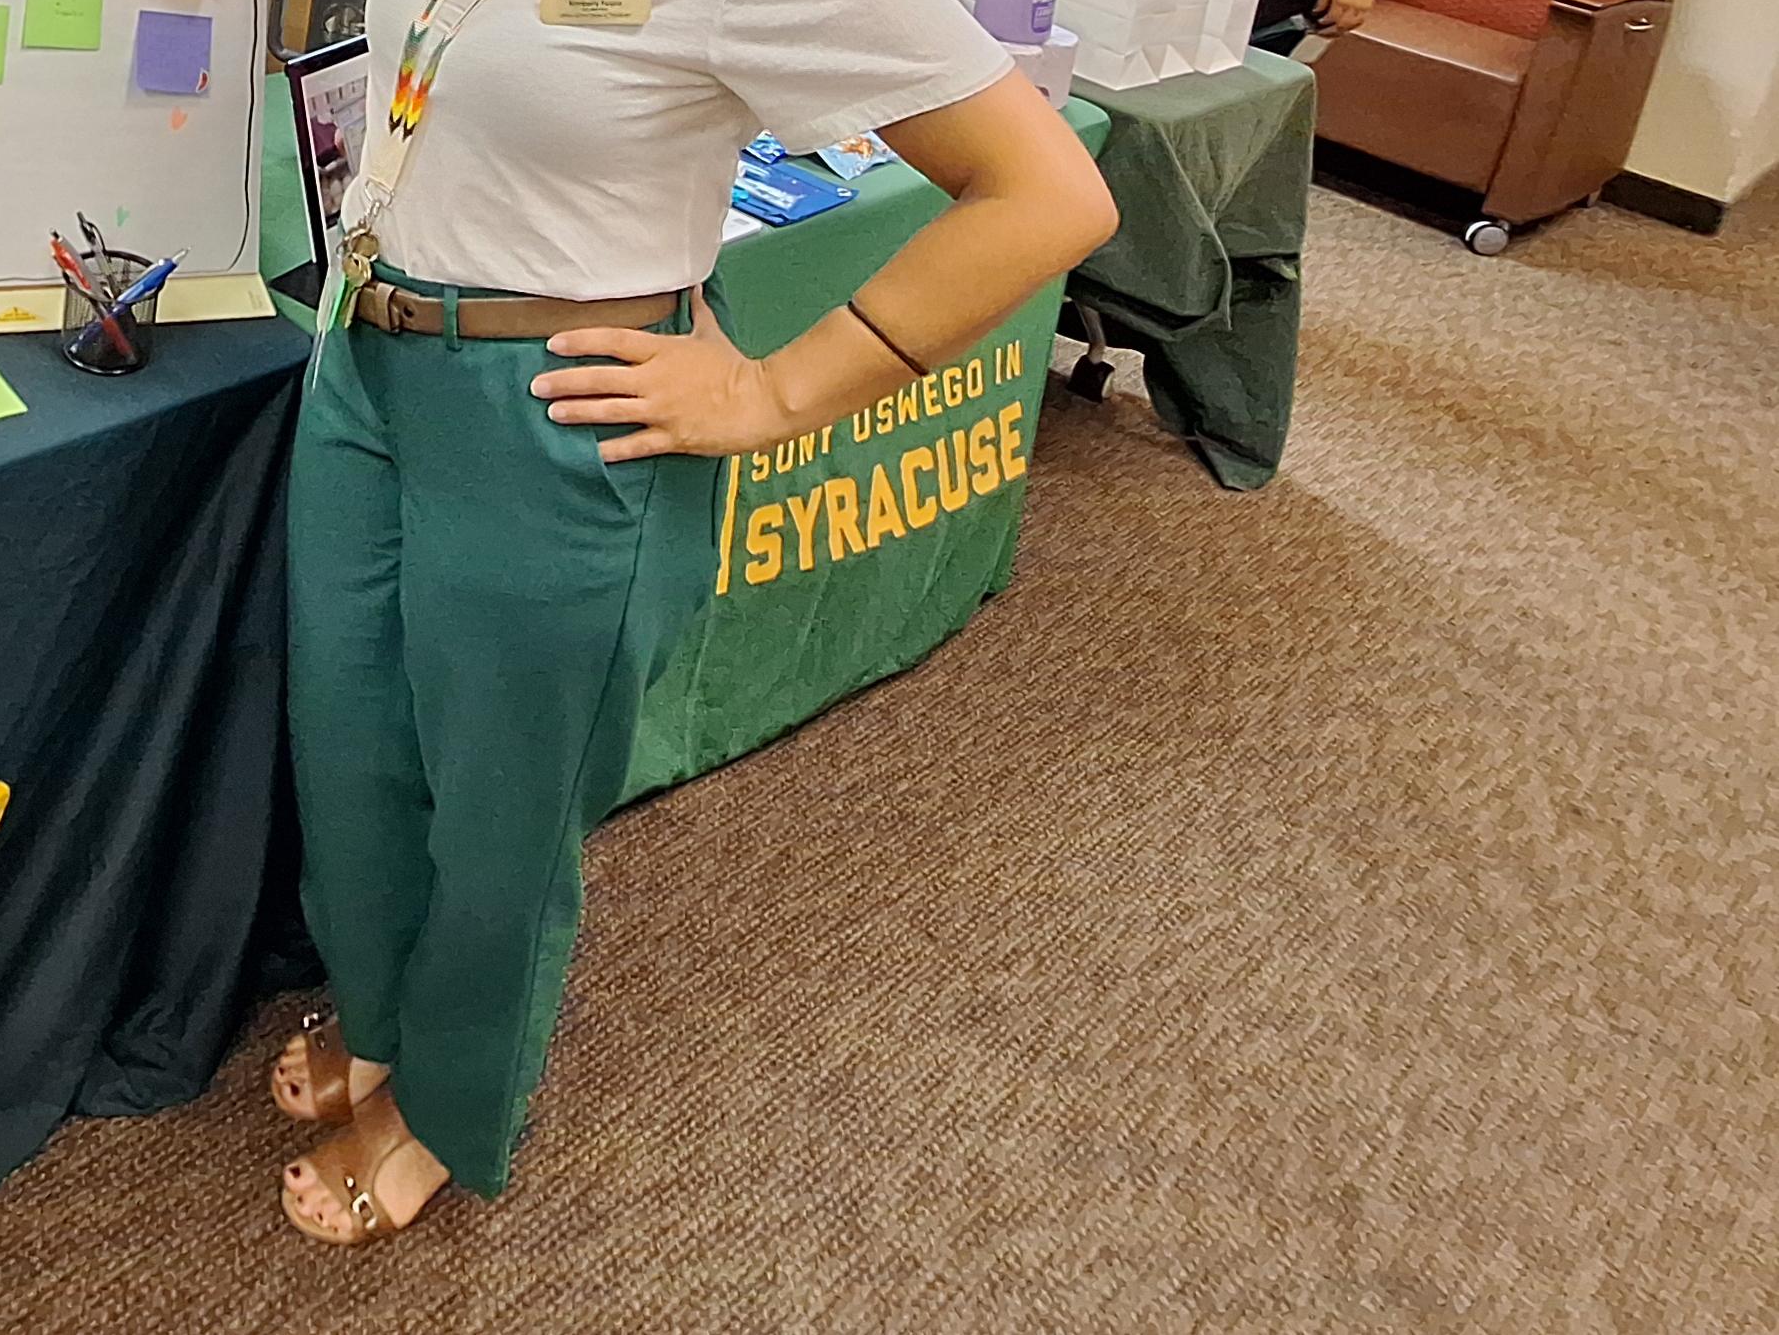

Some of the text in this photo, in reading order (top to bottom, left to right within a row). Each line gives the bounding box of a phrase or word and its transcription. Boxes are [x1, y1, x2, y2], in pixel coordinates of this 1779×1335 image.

[751, 425, 833, 482] SUNY
[995, 339, 1022, 385] IN
[744, 401, 1027, 586] SYRACUSE
